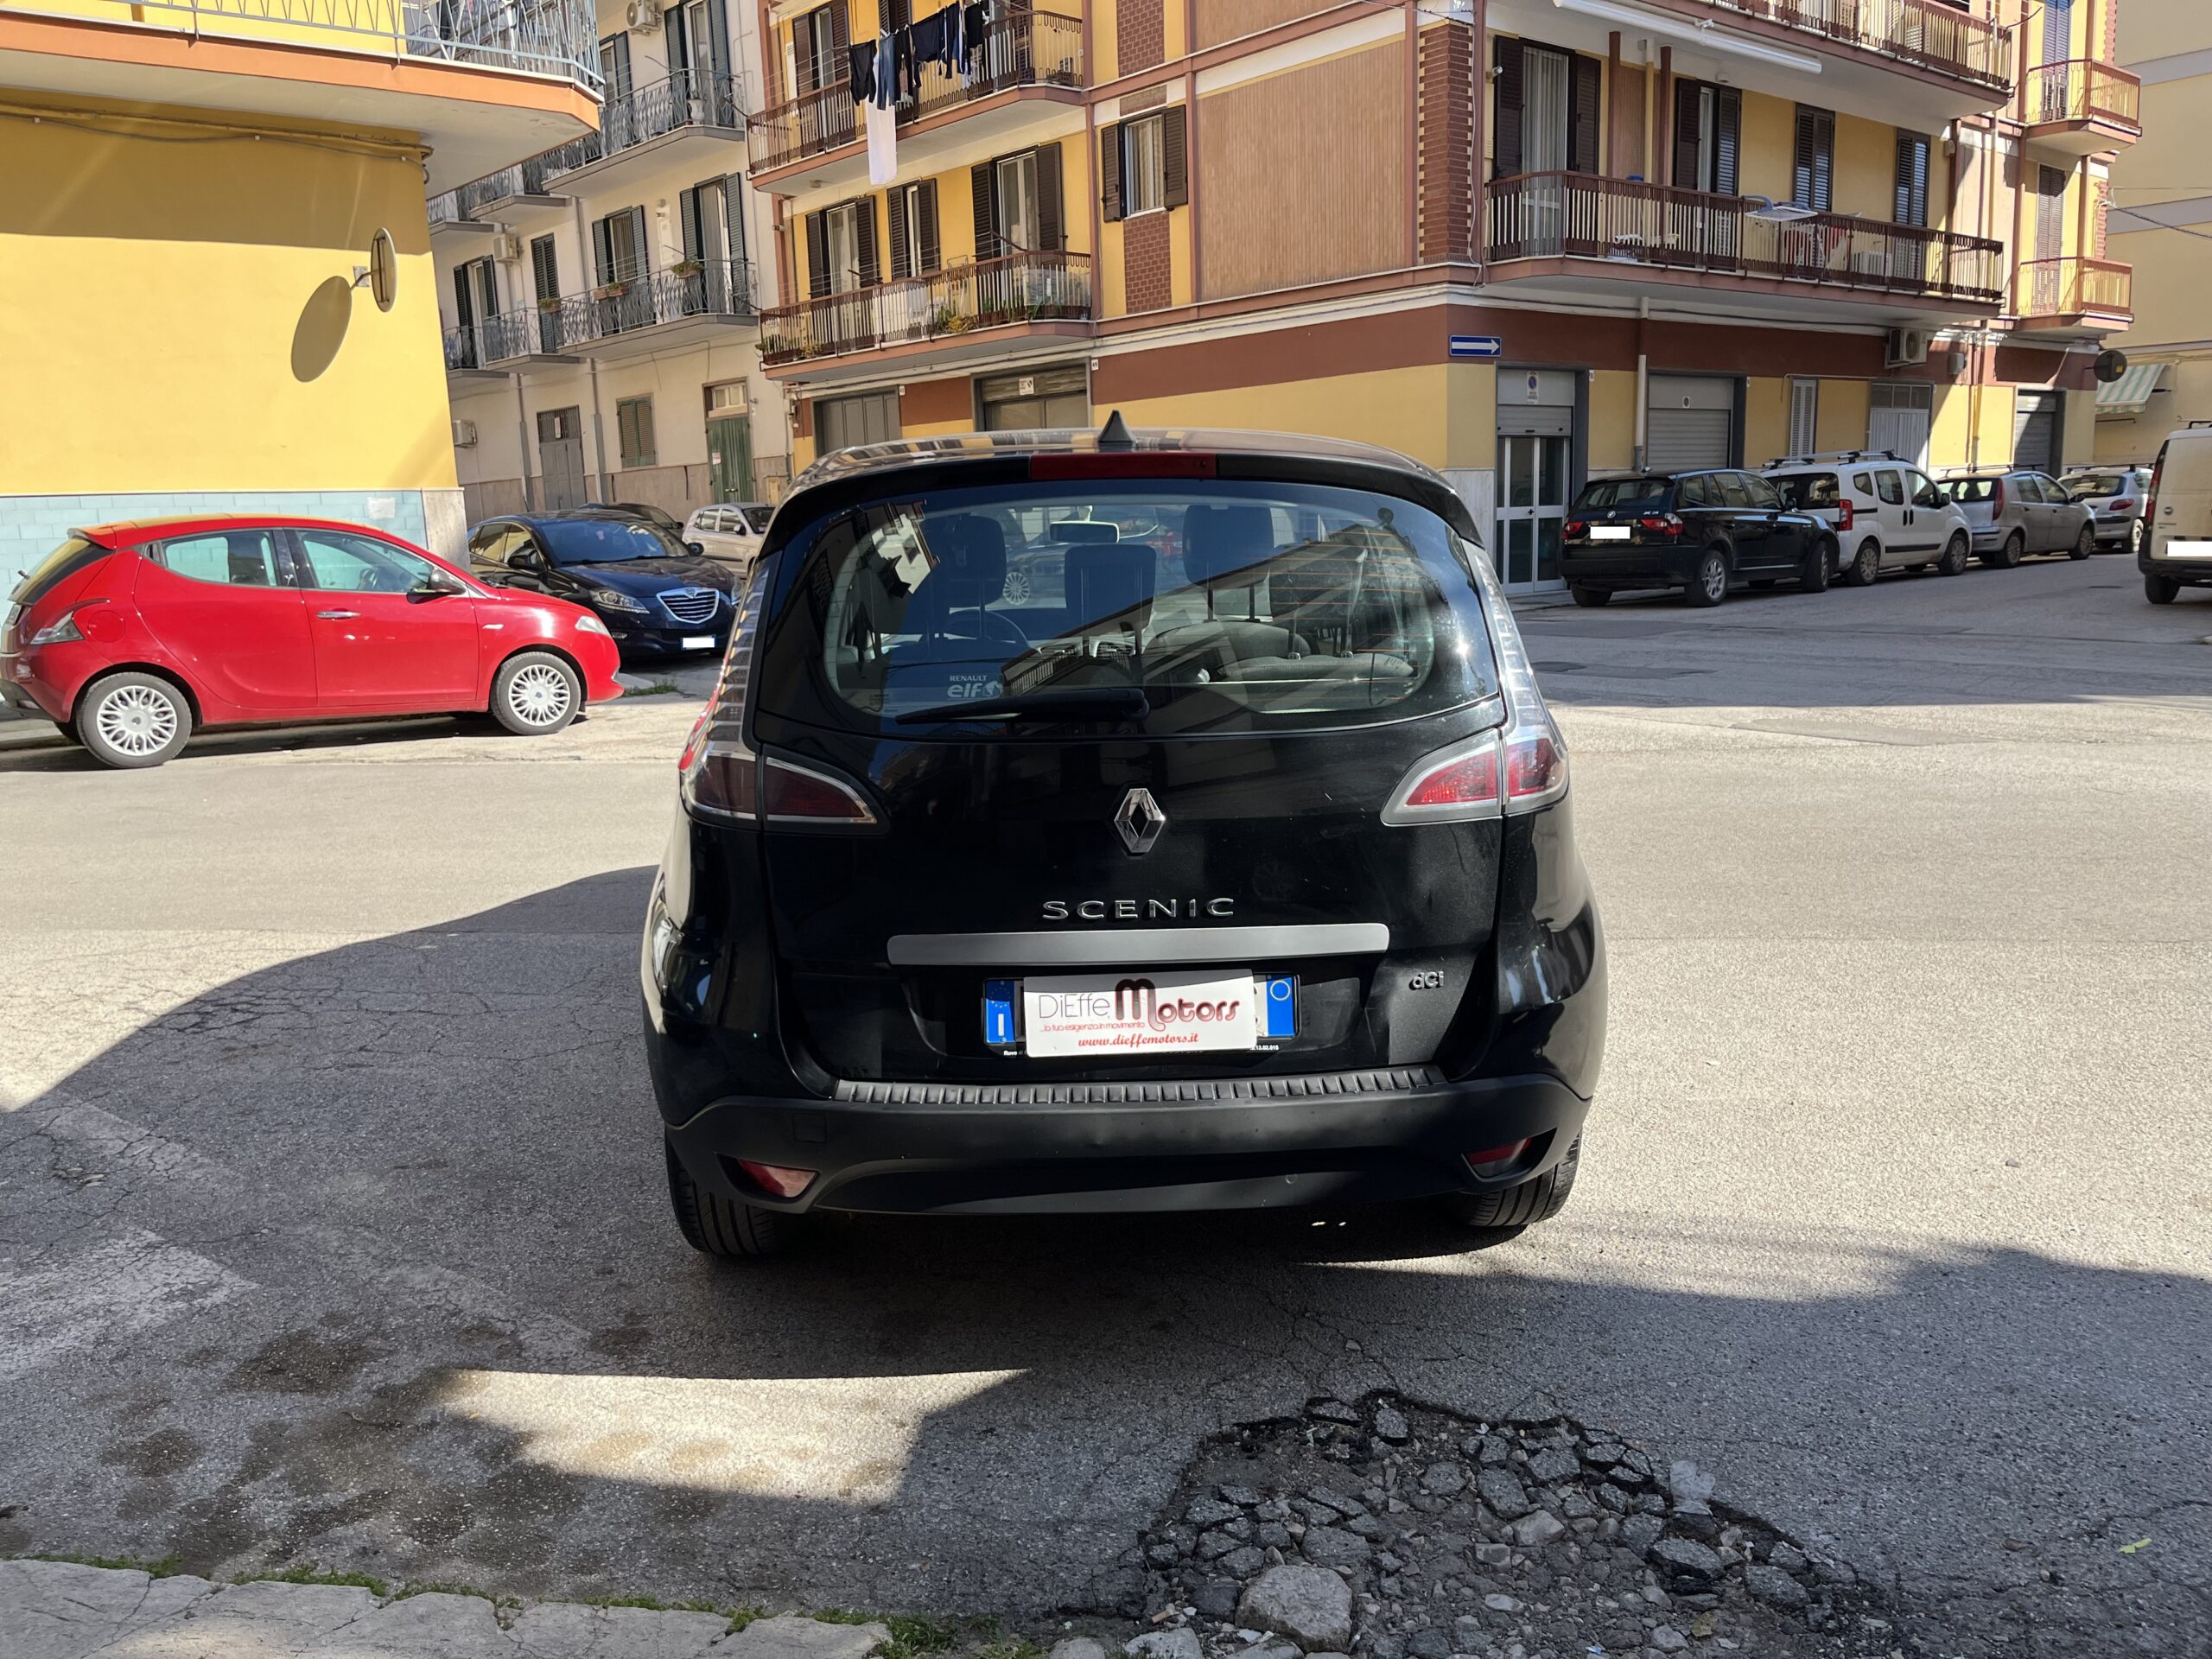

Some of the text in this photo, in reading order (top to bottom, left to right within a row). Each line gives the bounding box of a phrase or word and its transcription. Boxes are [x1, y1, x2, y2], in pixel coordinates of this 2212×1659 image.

[947, 683, 982, 698] elf
[1042, 897, 1235, 921] SCENIC
[1106, 1021, 1146, 1030] movimento
[1077, 1033, 1199, 1049] www.dieffemotors.it
